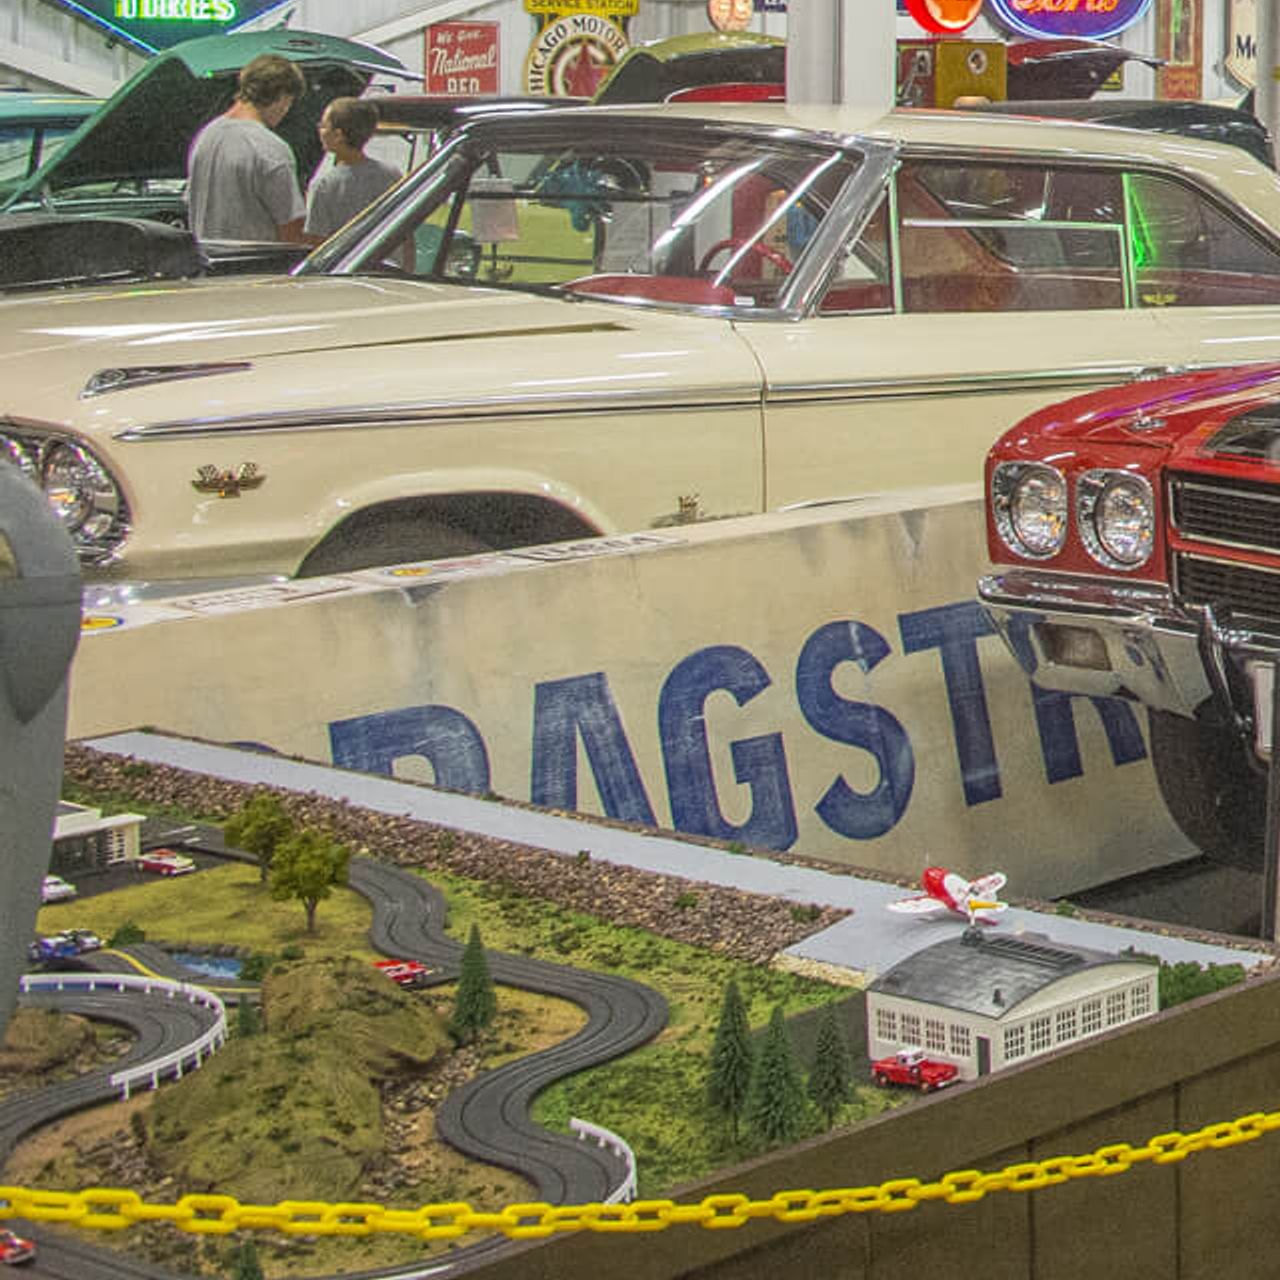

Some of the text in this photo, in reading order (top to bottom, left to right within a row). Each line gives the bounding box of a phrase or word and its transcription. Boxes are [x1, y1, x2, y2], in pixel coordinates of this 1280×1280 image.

[431, 42, 496, 74] National
[531, 16, 625, 91] HICAGO MOTOR
